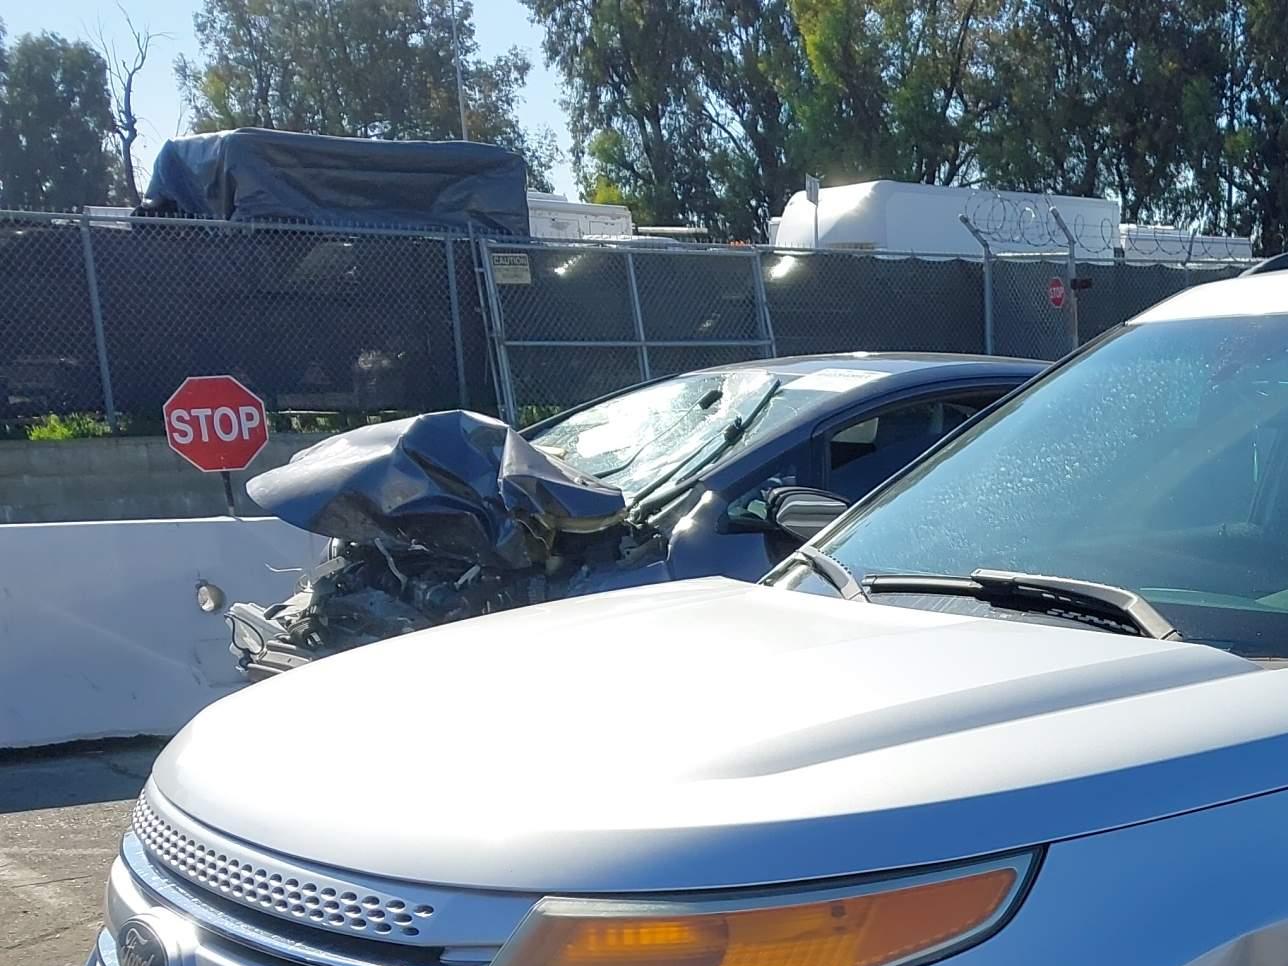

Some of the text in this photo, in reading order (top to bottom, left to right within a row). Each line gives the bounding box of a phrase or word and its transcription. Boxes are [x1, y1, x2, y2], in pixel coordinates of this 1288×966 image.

[493, 256, 527, 265] CAUTION
[1049, 287, 1064, 298] STOP
[170, 406, 260, 445] STOP
